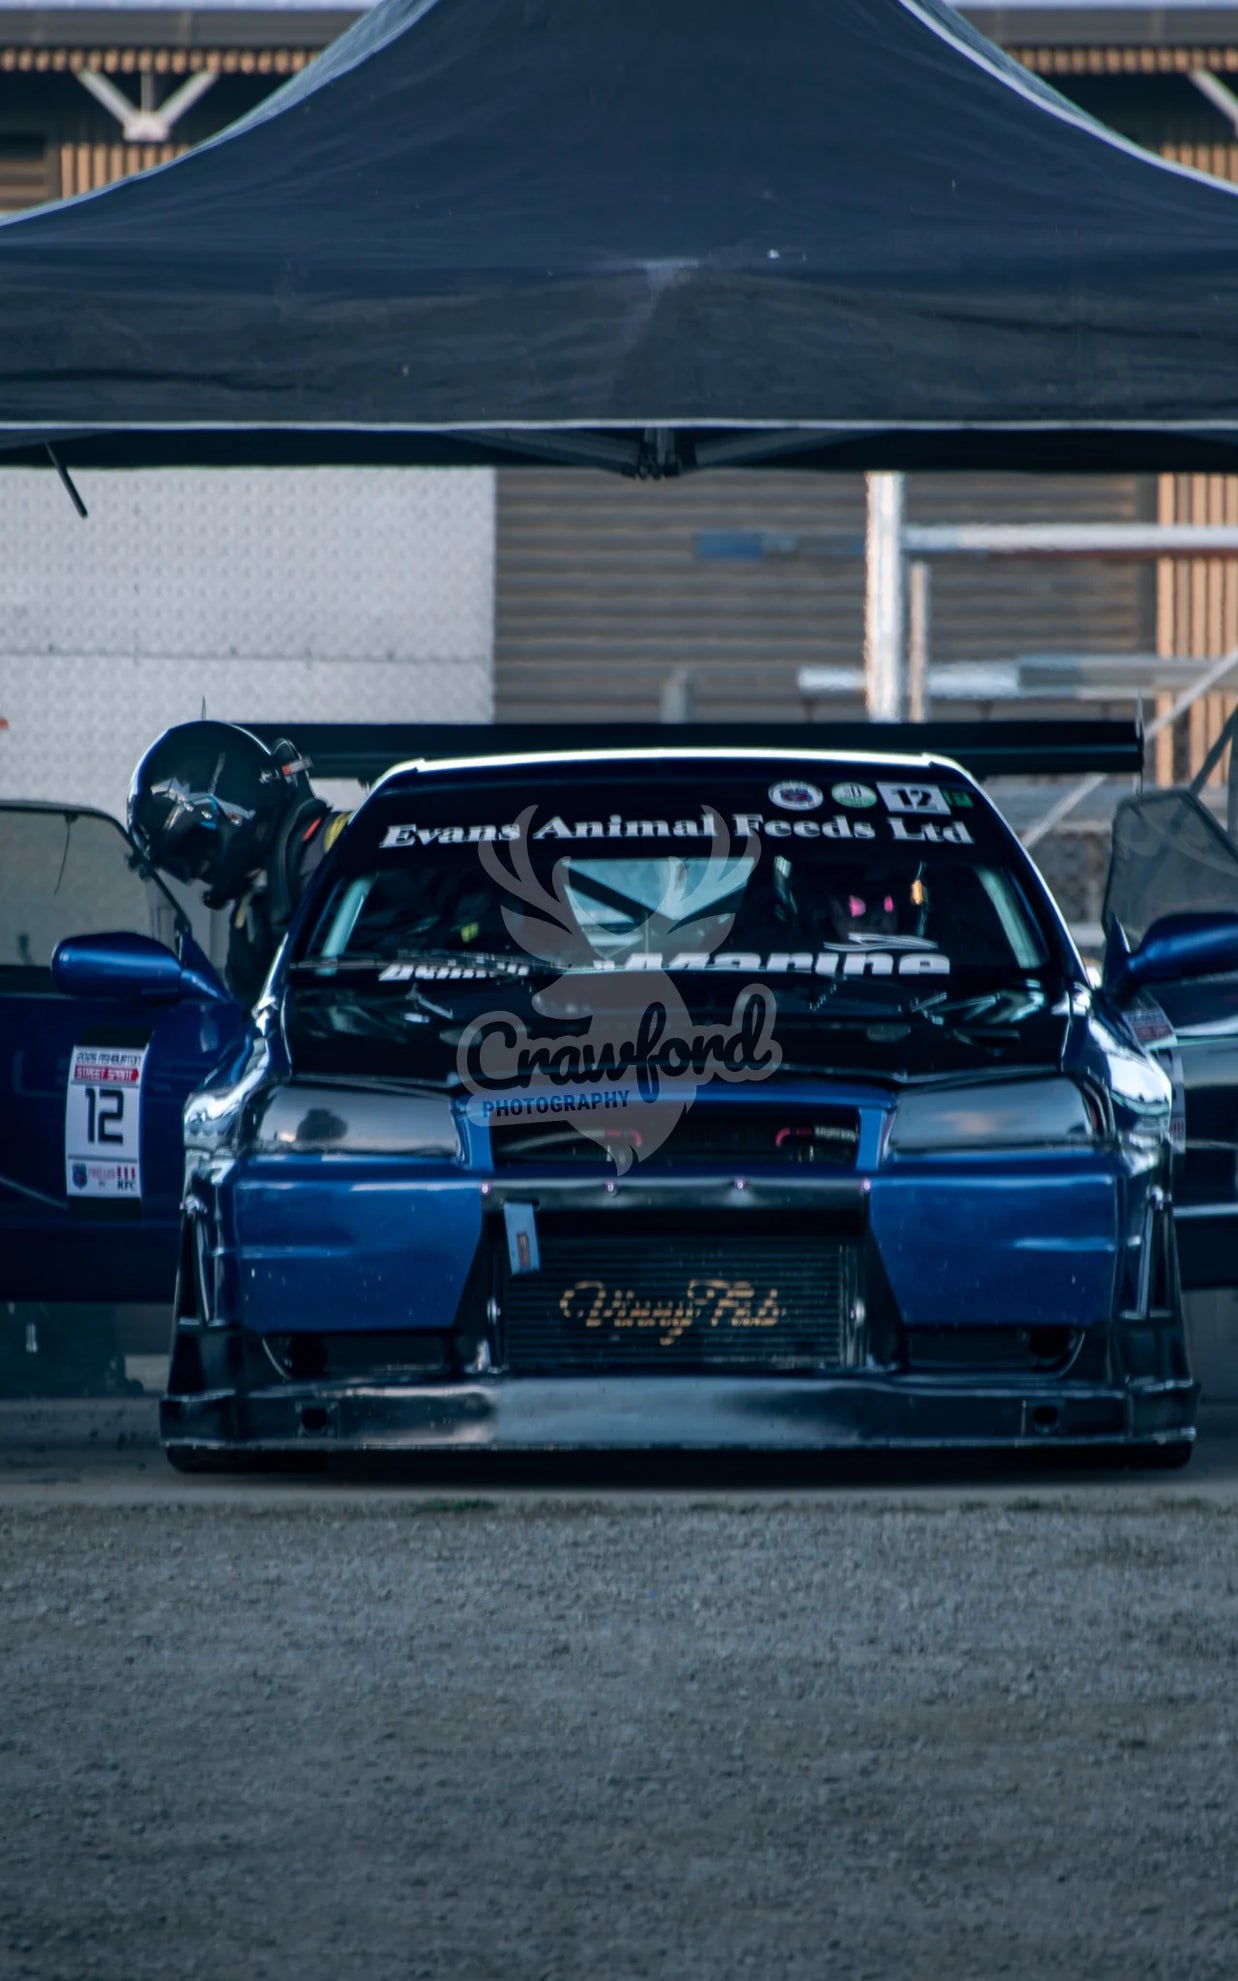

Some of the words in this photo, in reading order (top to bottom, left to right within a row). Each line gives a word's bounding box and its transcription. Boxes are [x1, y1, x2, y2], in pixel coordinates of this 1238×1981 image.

[893, 787, 941, 810] 12
[379, 822, 521, 849] Evans
[532, 813, 717, 840] Animal
[733, 813, 876, 840] Feeds
[891, 816, 975, 844] Ltd
[85, 1086, 124, 1145] 12
